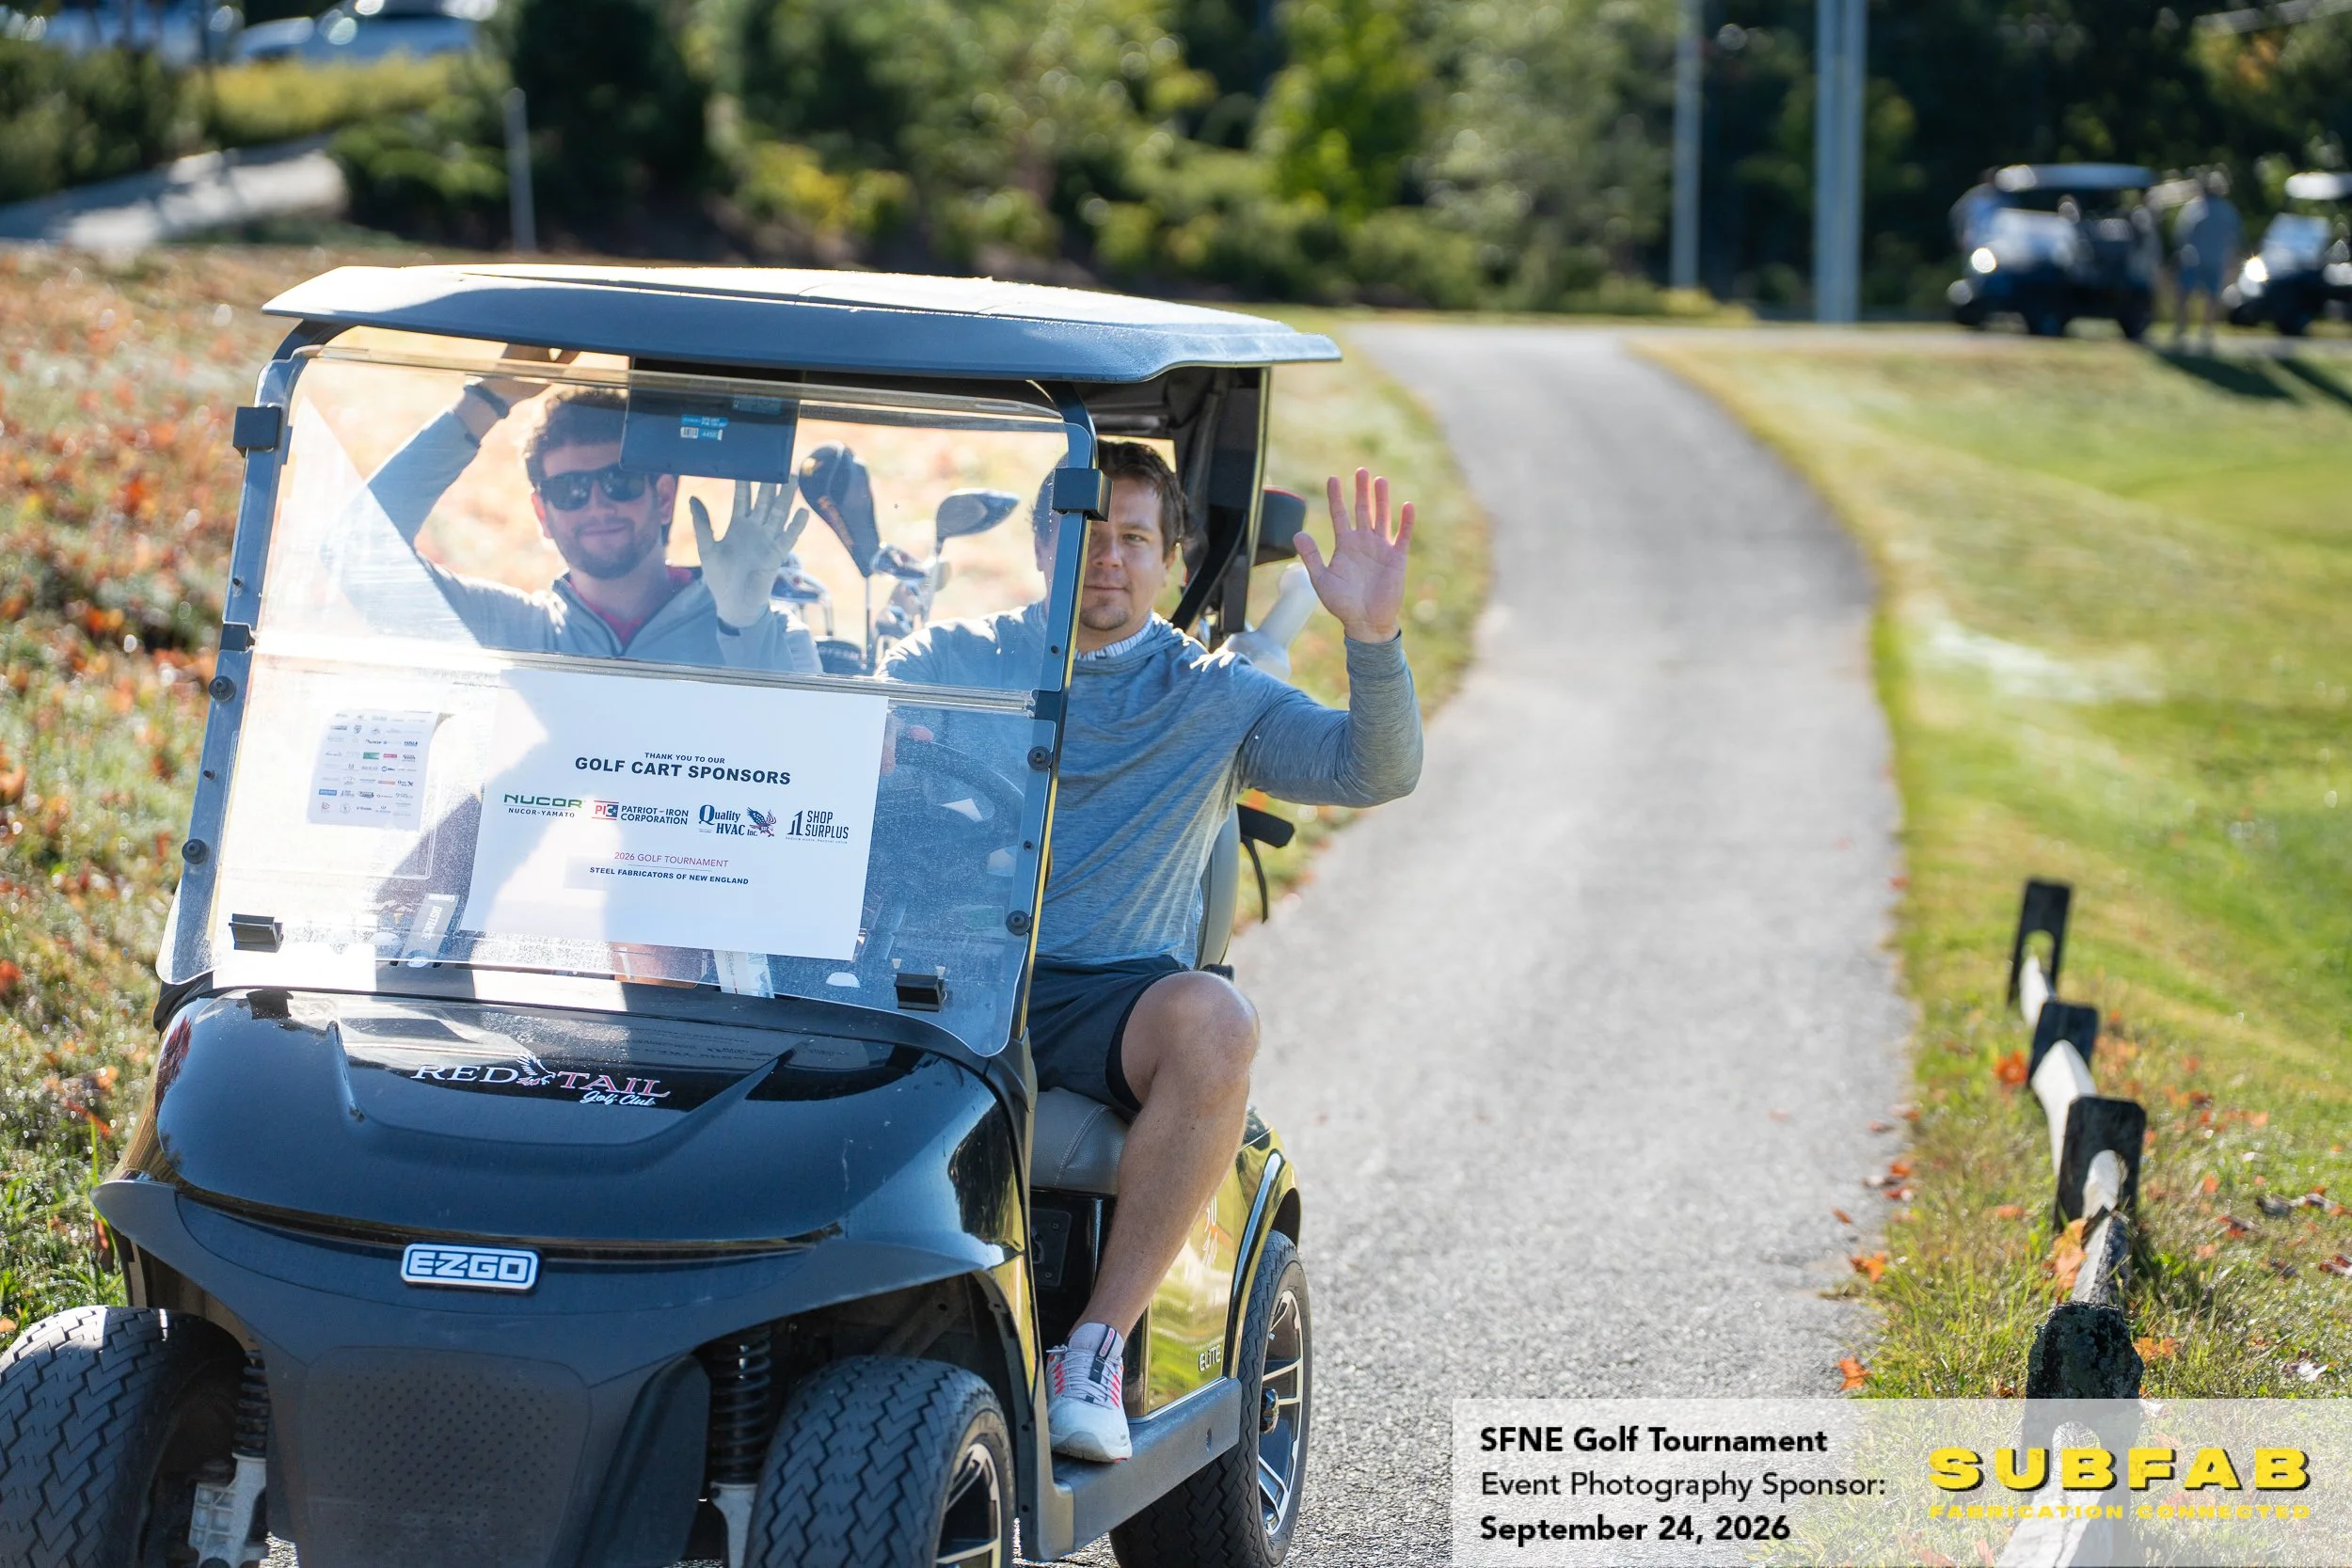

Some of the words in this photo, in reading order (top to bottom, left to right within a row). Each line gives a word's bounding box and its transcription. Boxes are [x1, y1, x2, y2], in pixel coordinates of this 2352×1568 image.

[575, 756, 626, 772] GOLF
[631, 761, 682, 777] CART
[688, 765, 791, 785] SPONSORS
[503, 794, 582, 809] NUCOR
[508, 807, 575, 818] NUCOR-YAMATO
[620, 813, 689, 825] CORPORATION
[698, 804, 741, 826] Quality
[806, 810, 834, 825] SHOP
[716, 822, 746, 836] HVAC
[747, 829, 758, 837] Inc.
[804, 824, 850, 839] SURPLUS
[614, 851, 635, 861] 2026
[637, 853, 662, 863] GOLF
[664, 855, 729, 867] TOURNAMENT
[589, 866, 615, 875] STEEL
[617, 869, 674, 879] FABRICATORS
[689, 874, 707, 882] NEW
[709, 876, 749, 885] ENGLAND
[410, 1065, 518, 1084] RED
[557, 1071, 671, 1098] TAIL
[580, 1090, 618, 1105] Golf
[618, 1093, 656, 1106] Club
